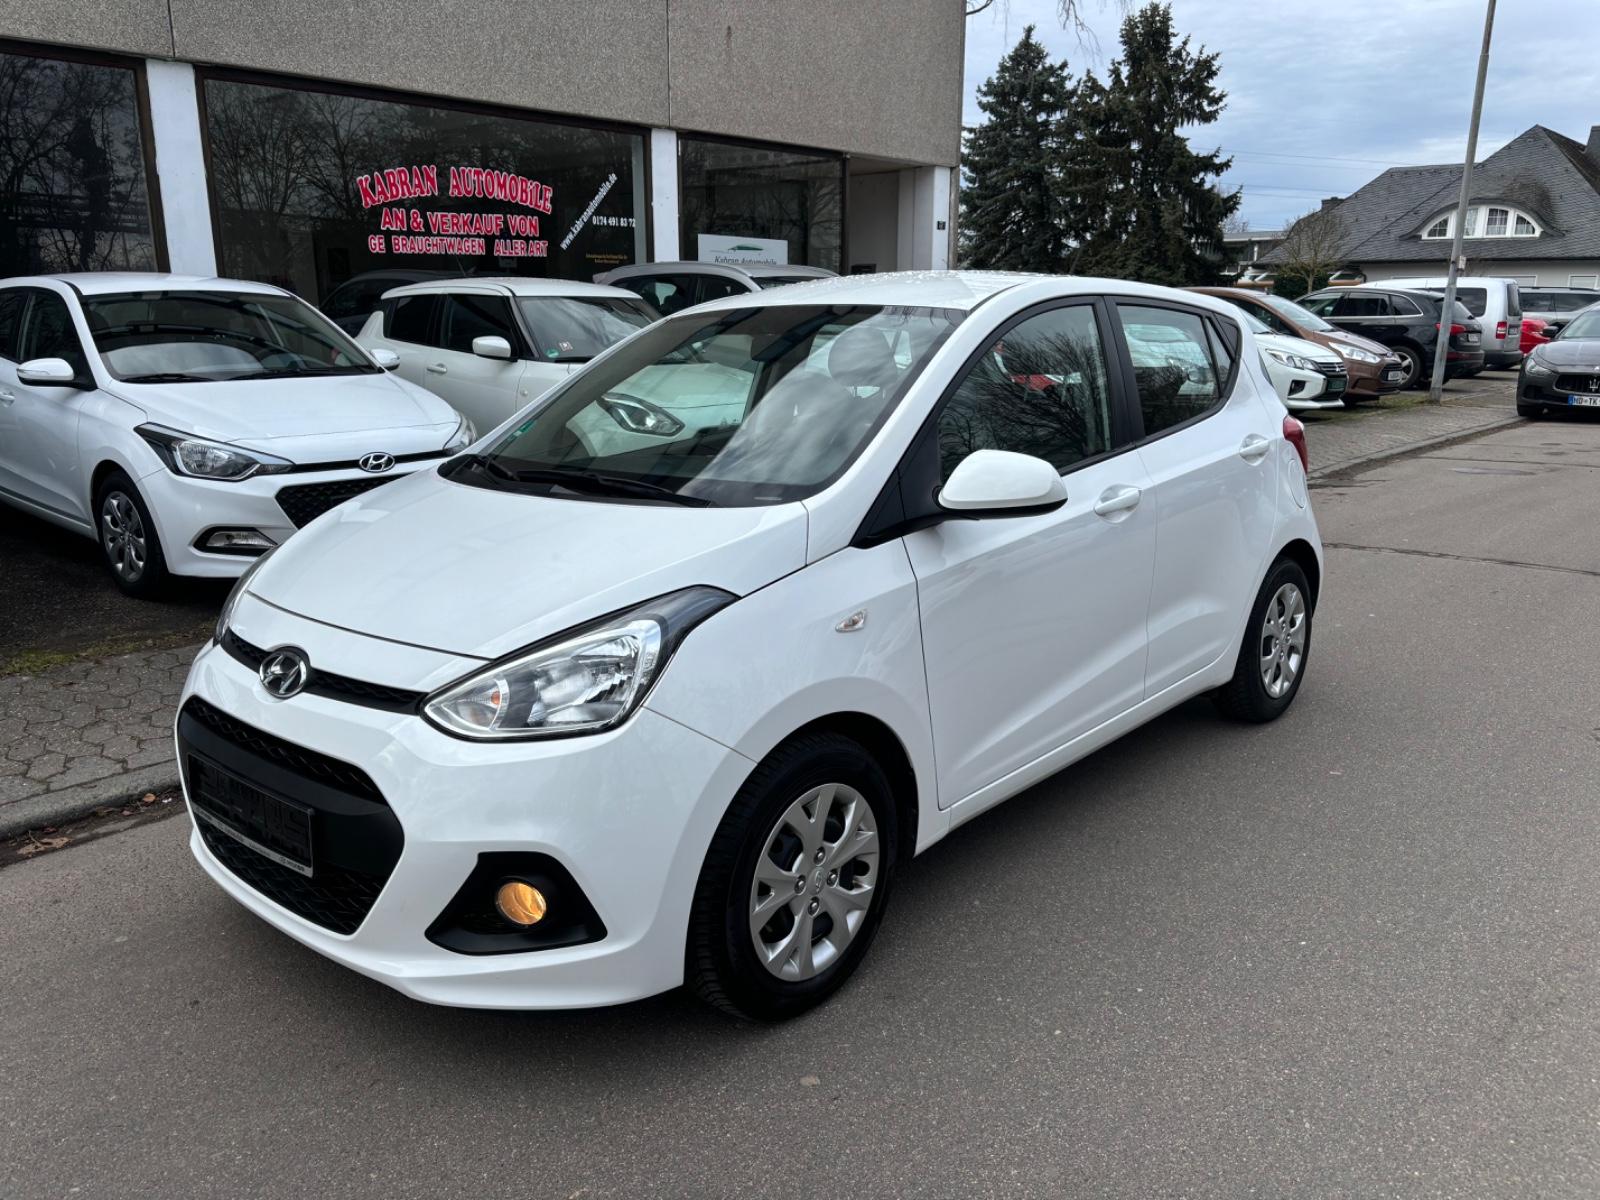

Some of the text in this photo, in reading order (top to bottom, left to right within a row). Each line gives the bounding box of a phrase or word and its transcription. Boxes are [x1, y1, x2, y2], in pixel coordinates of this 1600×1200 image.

[357, 165, 439, 208] KABRAN
[381, 208, 540, 237] AN & VERKAUF VON
[368, 235, 386, 253] GE
[392, 235, 485, 255] BRAUCHTWAGEN
